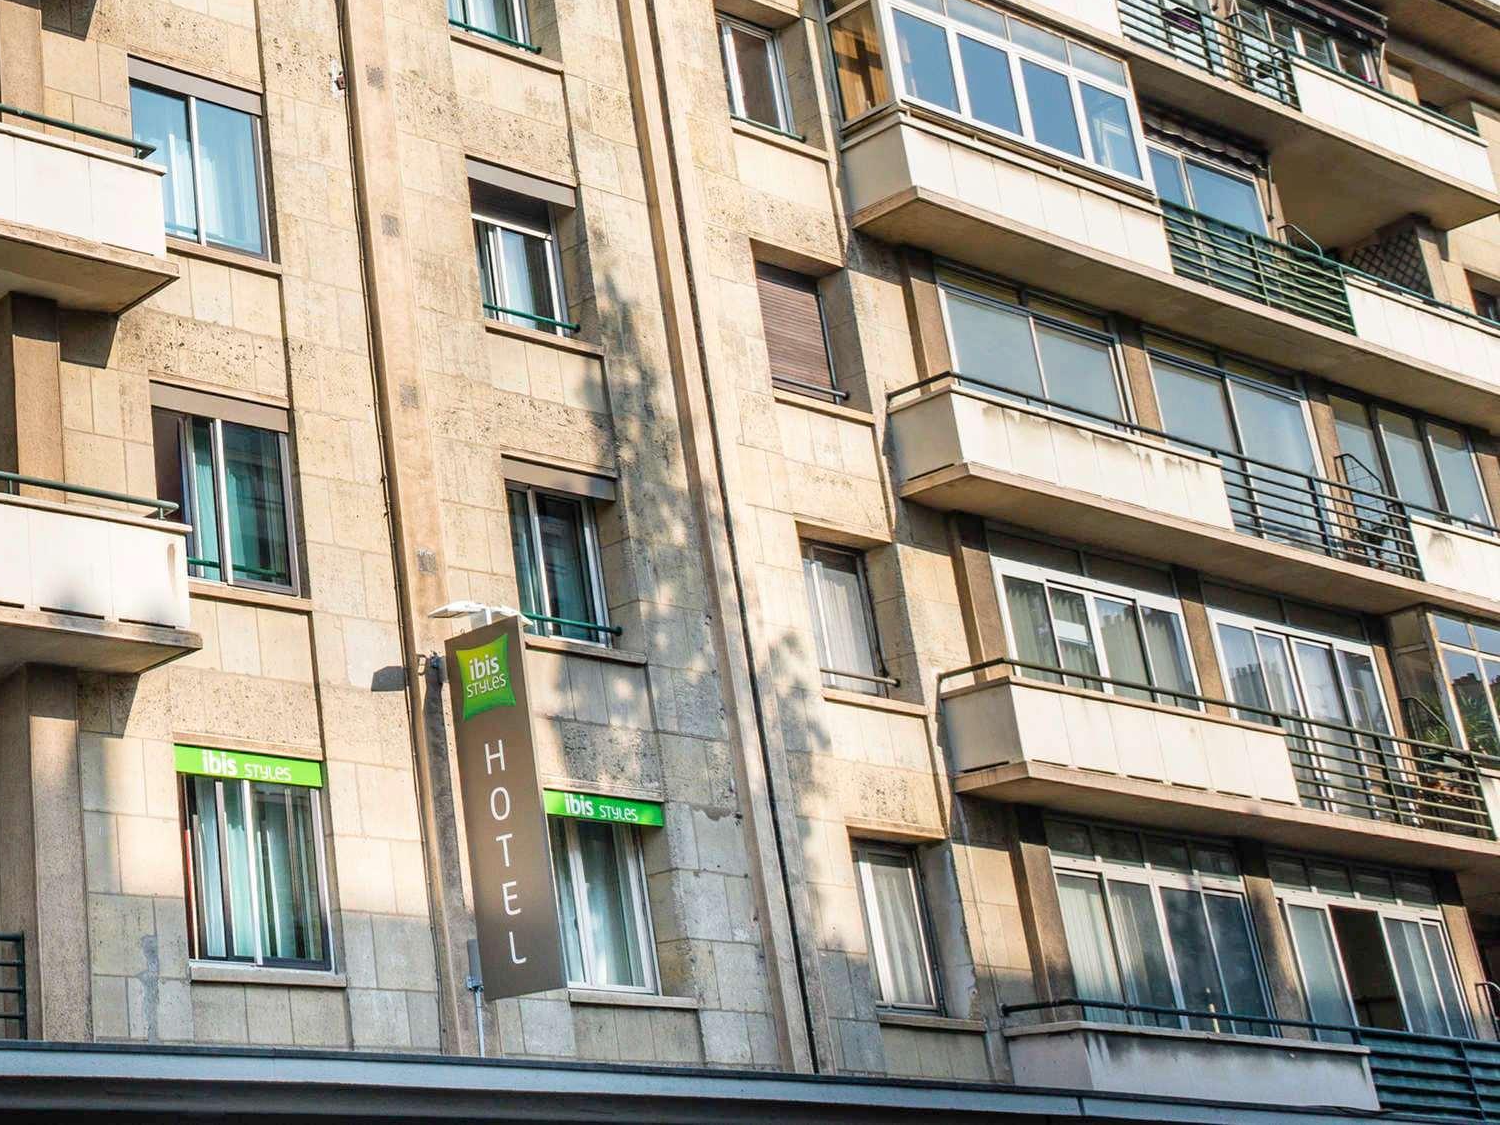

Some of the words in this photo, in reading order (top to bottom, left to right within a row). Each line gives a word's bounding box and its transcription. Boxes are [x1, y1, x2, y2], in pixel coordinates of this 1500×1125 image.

[469, 654, 499, 680] ibis
[202, 749, 238, 776] ibis
[564, 793, 595, 816] ibis
[484, 739, 526, 965] HOTEL
